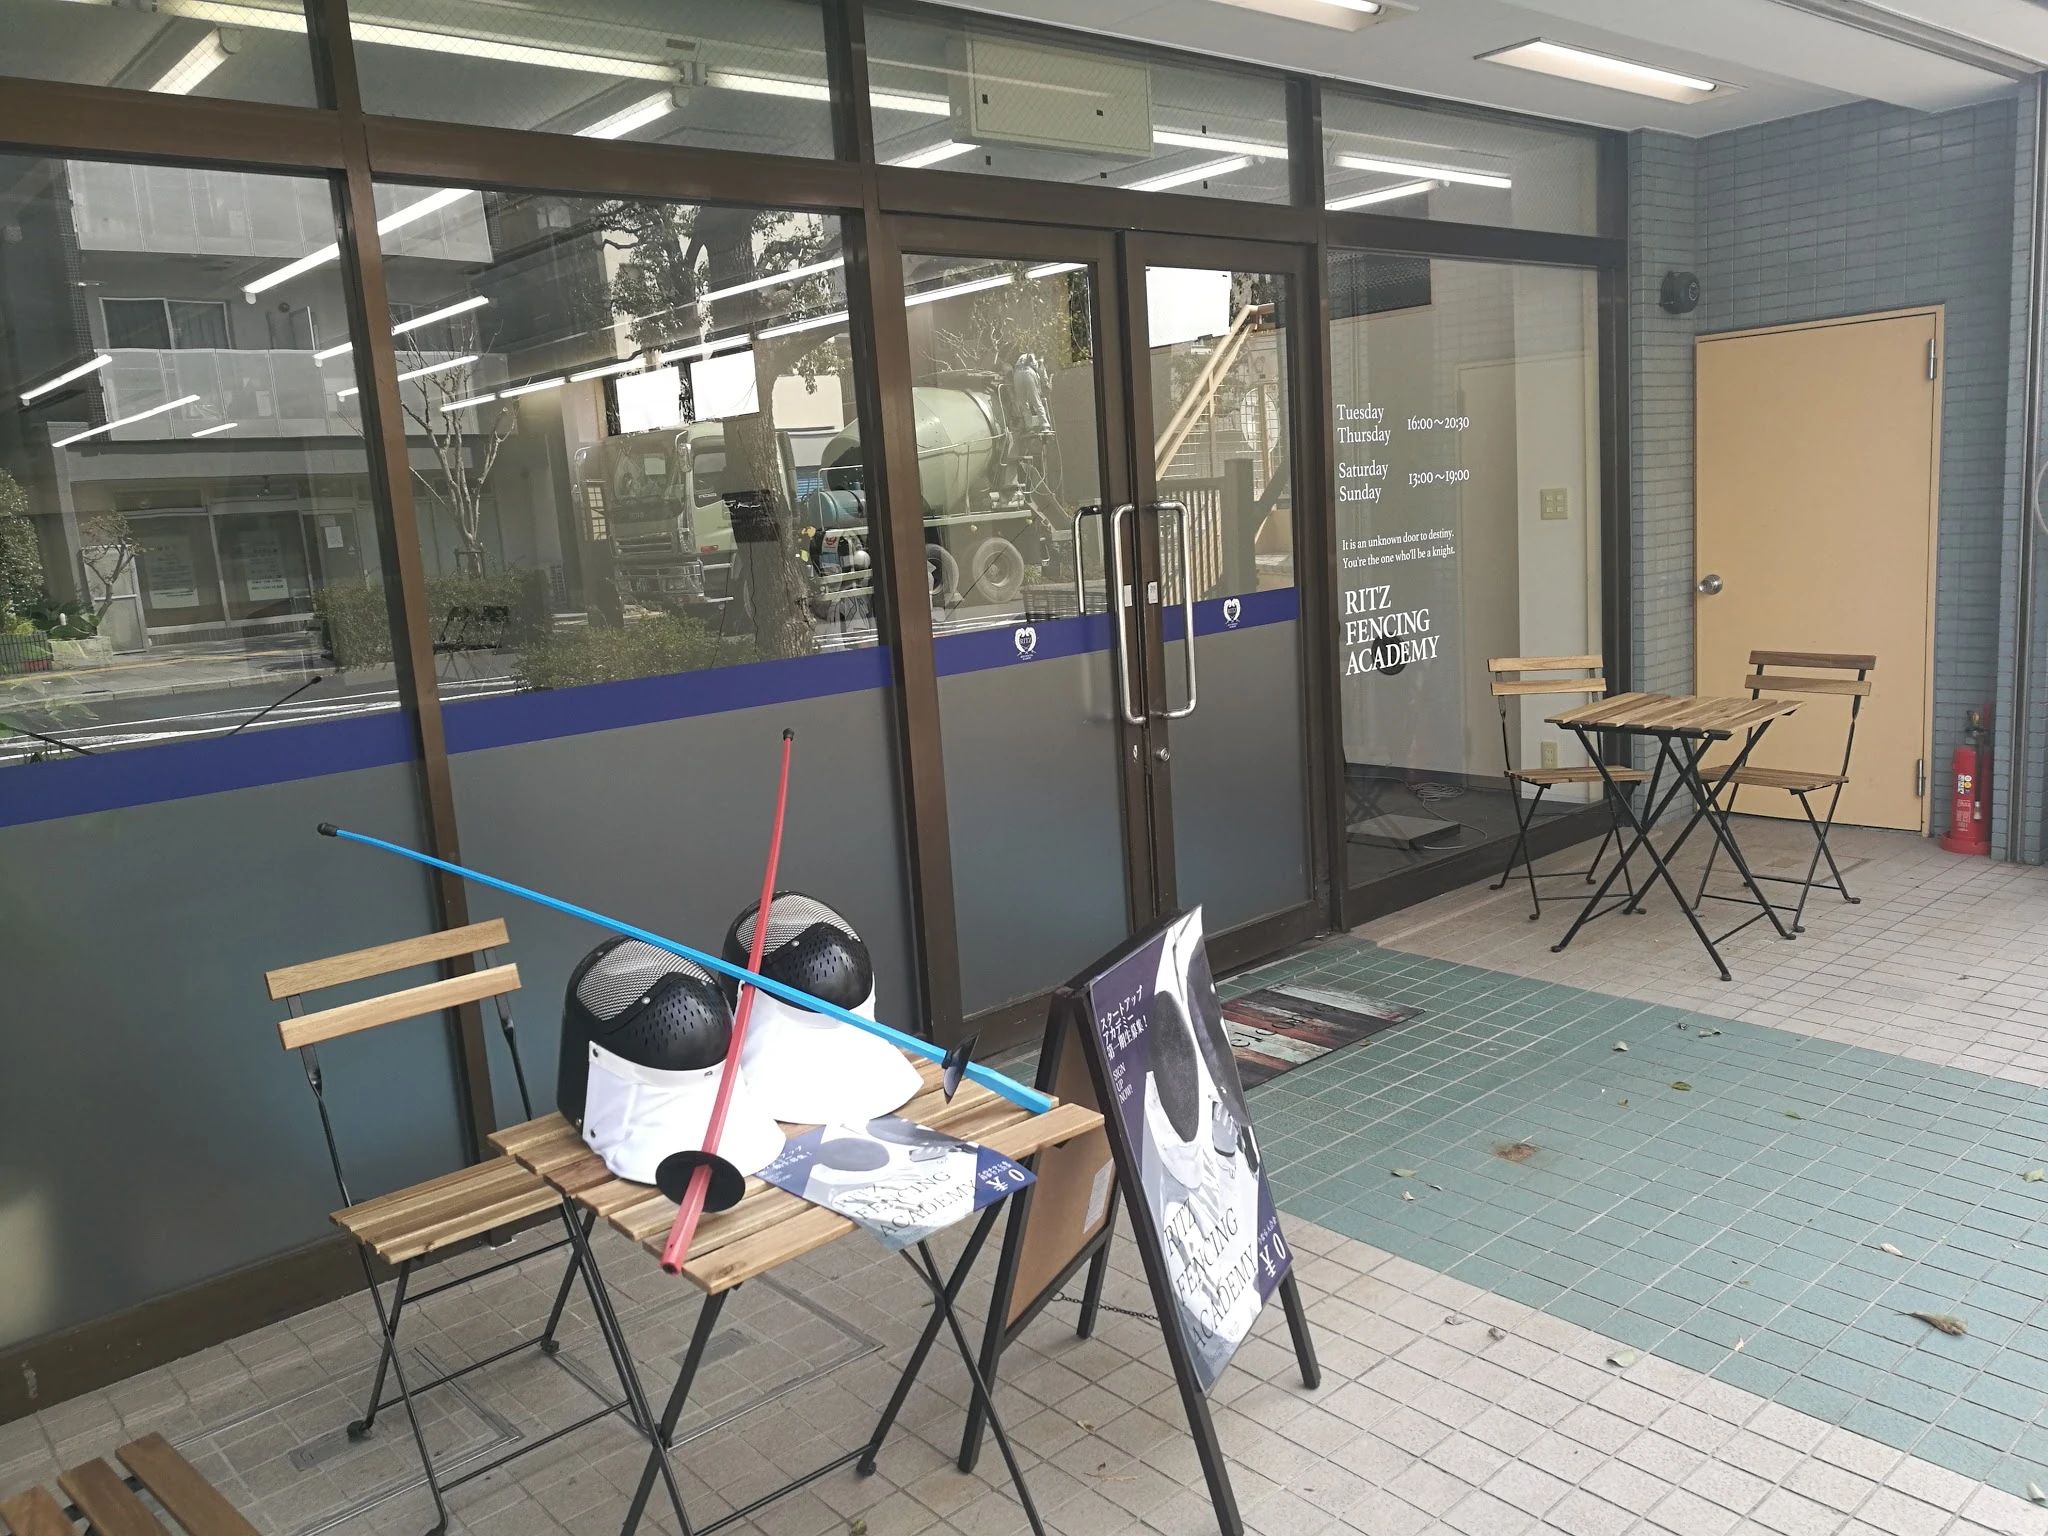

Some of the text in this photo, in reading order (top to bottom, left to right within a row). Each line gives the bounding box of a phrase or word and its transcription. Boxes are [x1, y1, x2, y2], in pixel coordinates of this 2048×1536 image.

[1336, 403, 1384, 423] Tuesday
[1337, 426, 1391, 445] Thursday
[1338, 460, 1388, 480] Saturday
[1339, 485, 1381, 503] Sunday
[1342, 527, 1455, 551] It is an unknown door to destiny.
[1342, 556, 1366, 570] You're
[1367, 554, 1379, 567] the
[1380, 554, 1394, 565] one
[1395, 549, 1417, 563] who'll
[1417, 547, 1426, 560] be
[1432, 544, 1455, 559] knight.
[1344, 584, 1392, 615] RITZ
[1345, 608, 1431, 646] FENCING
[1345, 635, 1440, 676] ACADEMY
[1100, 984, 1143, 1031] スタートアップ
[1102, 1014, 1135, 1046] アカデミー
[1112, 1062, 1126, 1082] SIGN
[1115, 1078, 1124, 1093] UP
[879, 1179, 976, 1238] ACADEMY
[1164, 1198, 1196, 1256] RITZ
[1176, 1207, 1239, 1306] FENCING
[1192, 1243, 1258, 1349] ACADEMY
